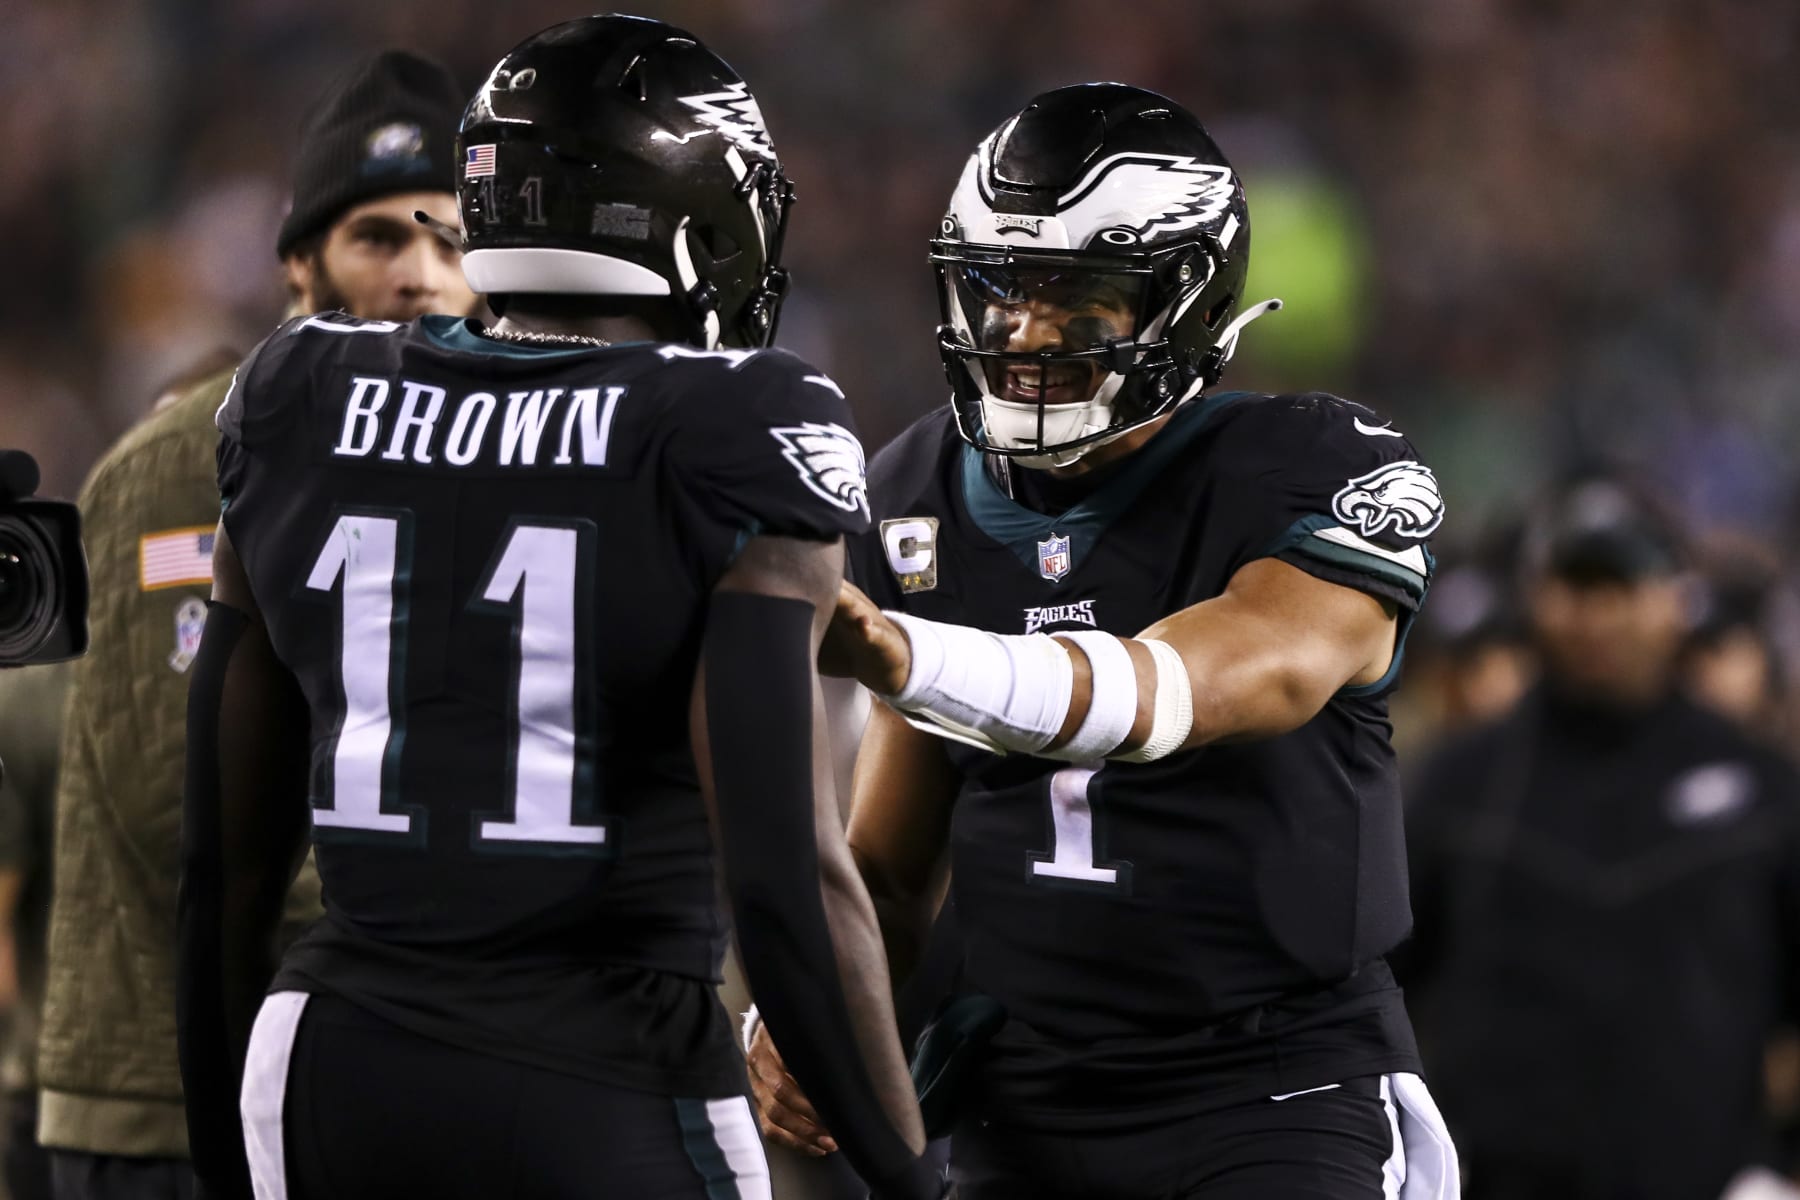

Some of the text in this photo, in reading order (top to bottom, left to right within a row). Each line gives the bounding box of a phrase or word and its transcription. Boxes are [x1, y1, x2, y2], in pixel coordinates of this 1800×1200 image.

[333, 376, 626, 467] BROWN
[885, 521, 932, 574] C
[1043, 553, 1067, 574] NFL
[1023, 599, 1098, 635] EAGLES
[304, 513, 607, 844] 11
